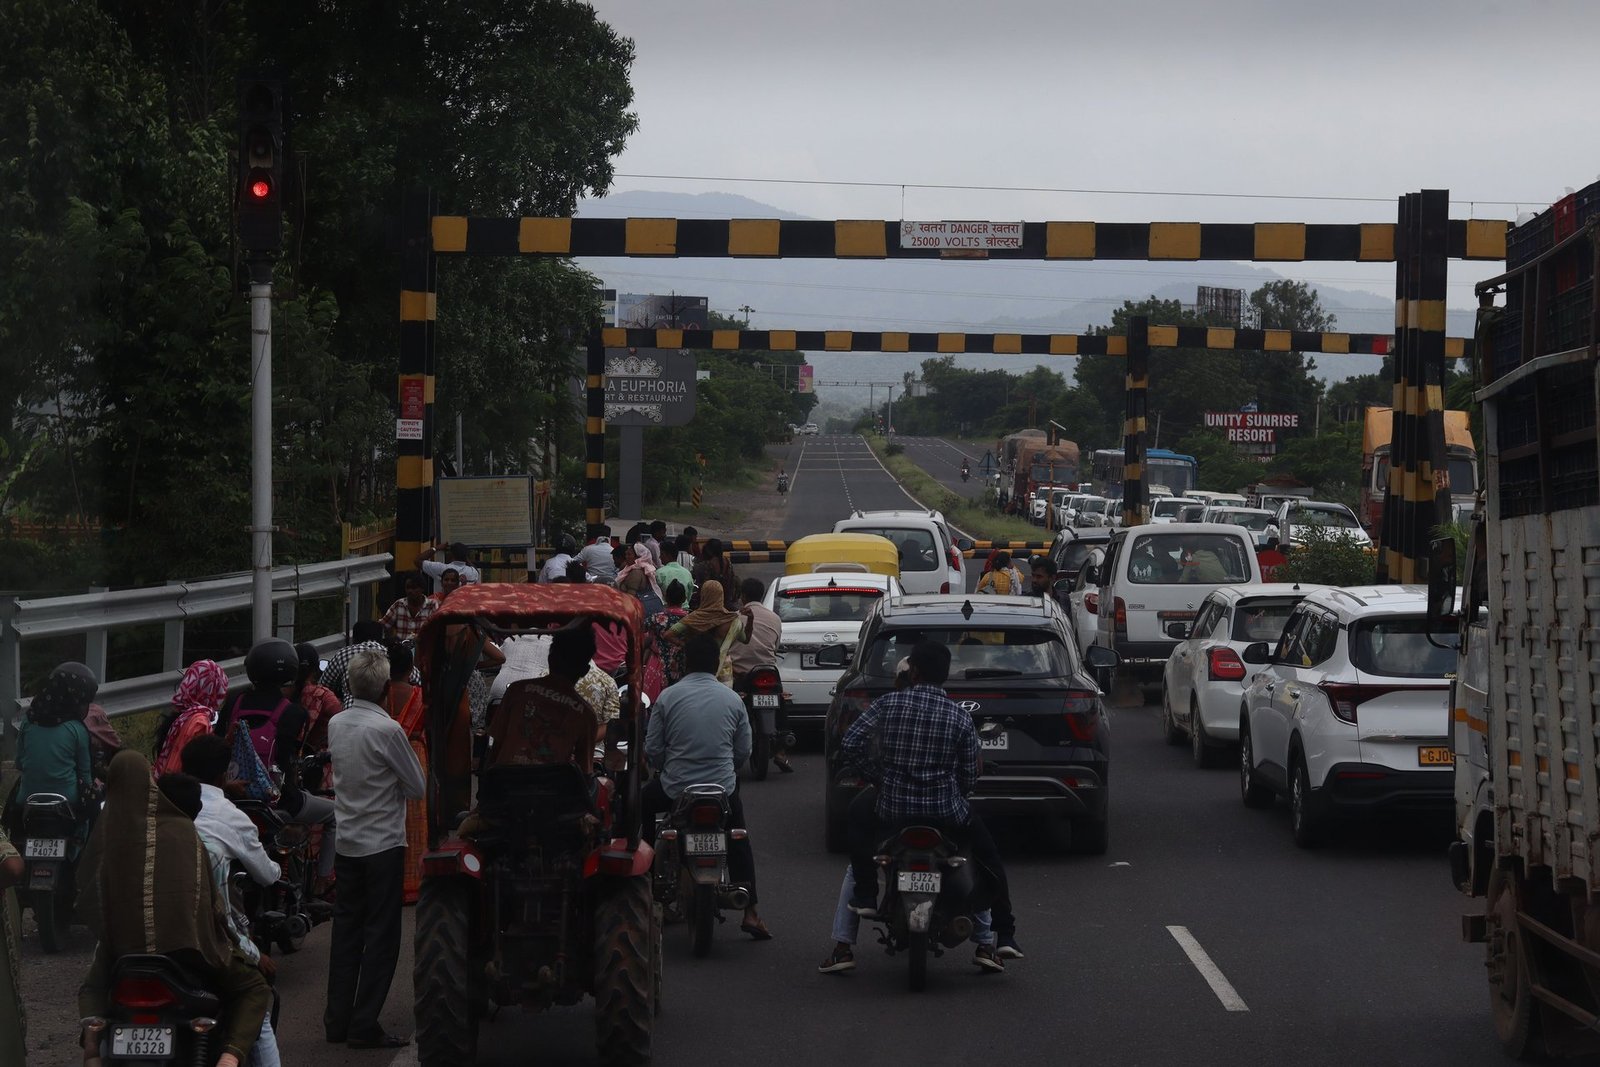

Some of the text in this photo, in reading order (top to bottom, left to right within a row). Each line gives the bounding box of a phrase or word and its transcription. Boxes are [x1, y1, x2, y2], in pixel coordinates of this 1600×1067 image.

[919, 223, 1019, 234] खतरा DANGER खतरा
[912, 236, 940, 247] 25000
[945, 237, 980, 247] VOLTS
[620, 380, 687, 393] EUPHORIA
[628, 394, 684, 402] RESTAURANT
[1207, 413, 1299, 427] UNITY SUNRISE
[1228, 428, 1274, 442] RESORT
[911, 872, 933, 882] GJ22
[909, 882, 936, 891] J5404
[132, 1028, 161, 1040] GJ22
[127, 1042, 164, 1054] K6328
